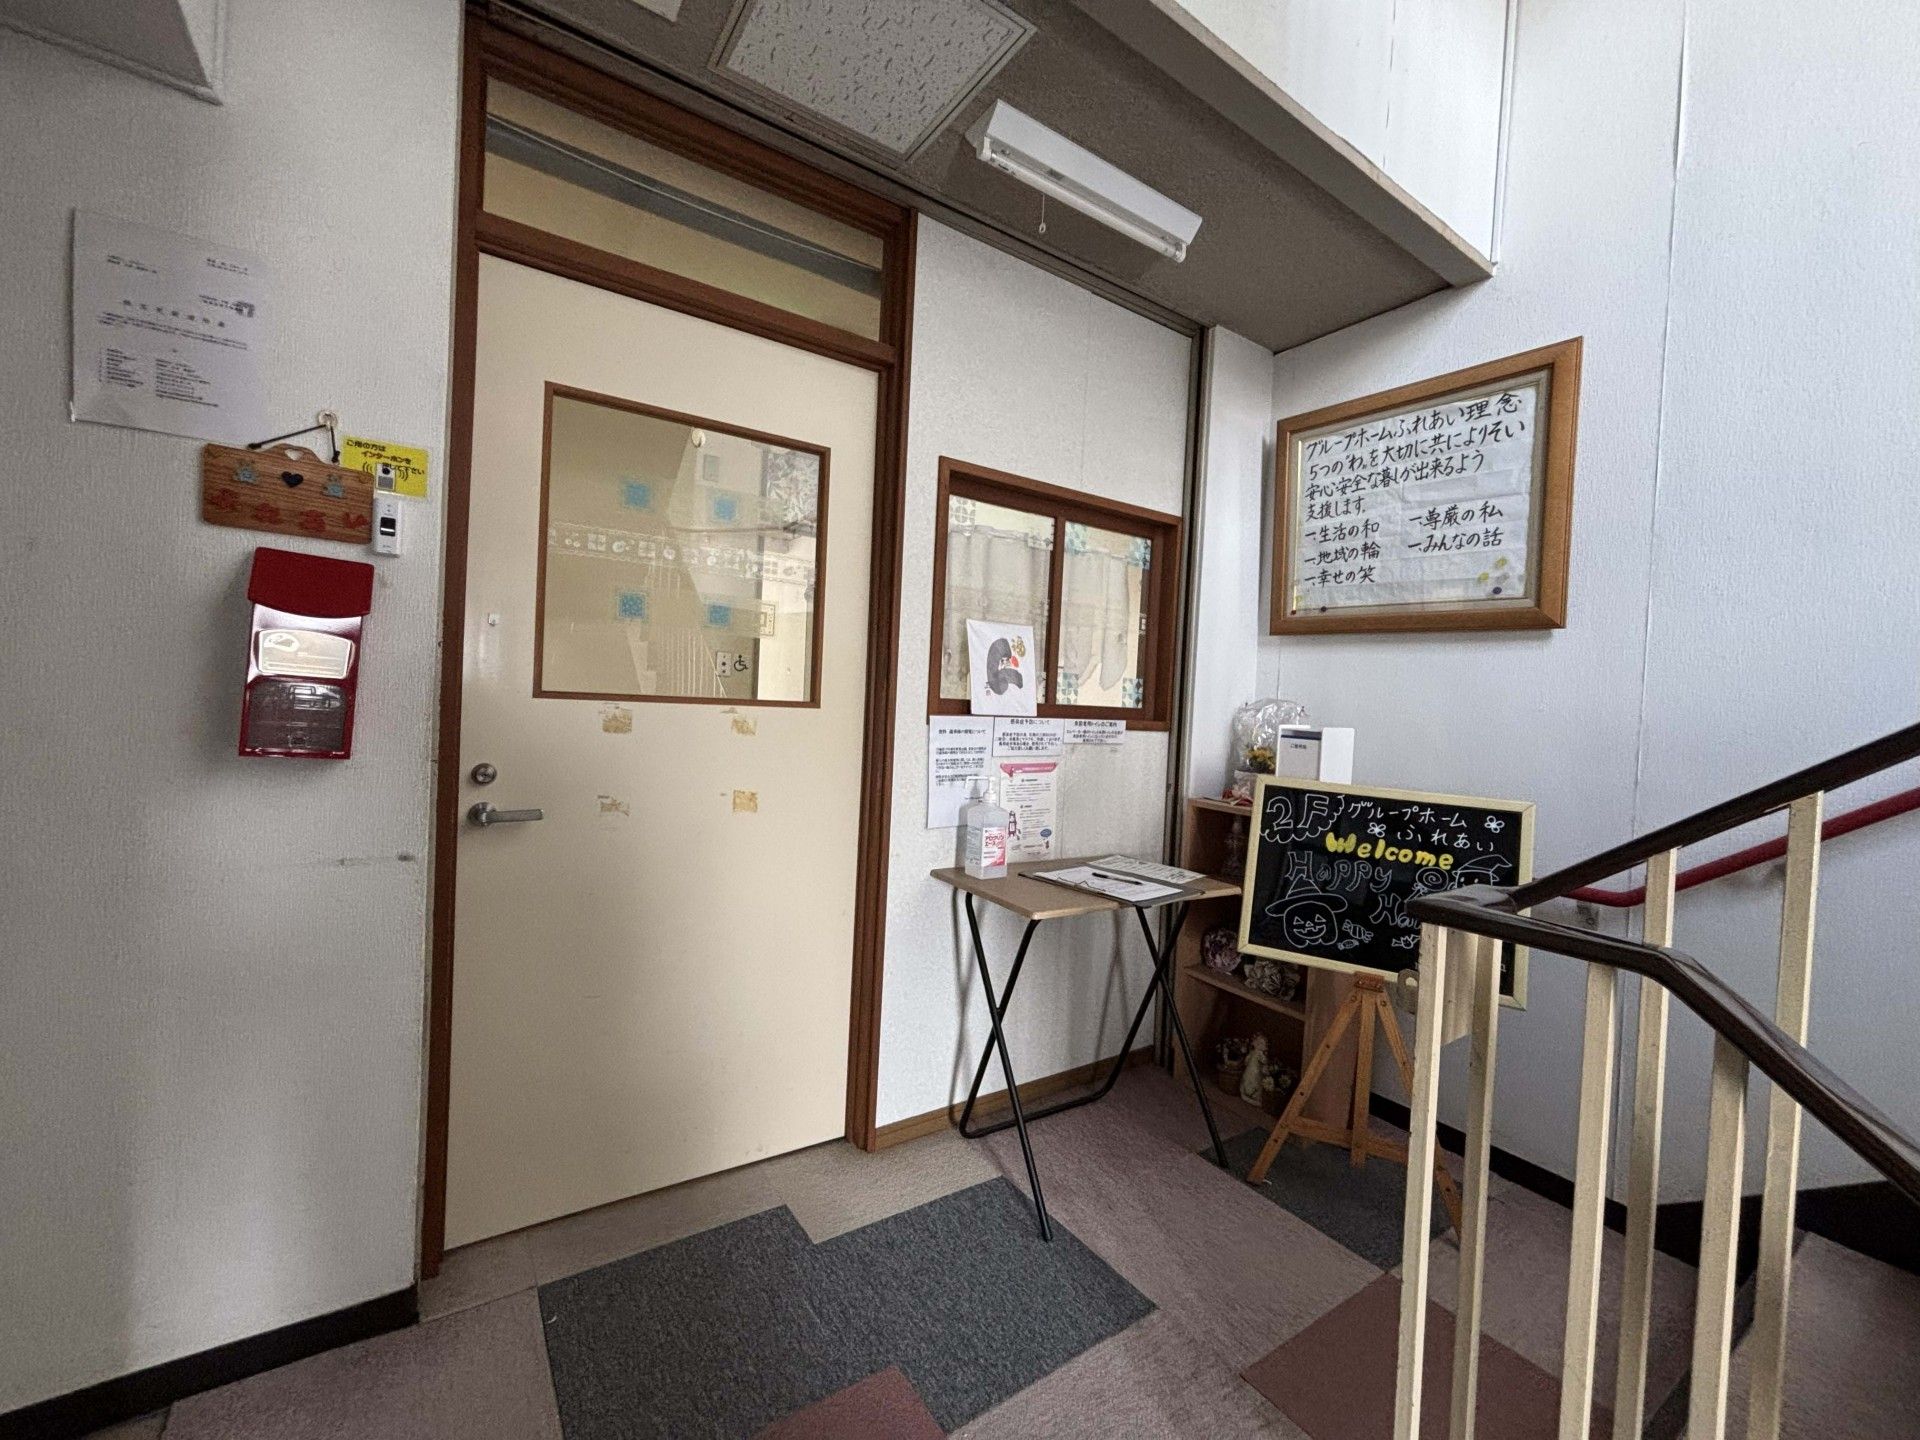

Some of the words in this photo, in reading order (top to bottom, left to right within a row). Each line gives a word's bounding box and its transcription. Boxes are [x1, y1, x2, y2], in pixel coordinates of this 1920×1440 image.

[1306, 393, 1522, 462] グループホームふれあい理念
[346, 439, 387, 452] ご用の方は
[361, 450, 412, 465] インターホンを
[1266, 793, 1330, 830] 2F
[1348, 801, 1468, 828] グループホーム
[1325, 832, 1454, 870] Welcome
[1397, 824, 1494, 851] ふれあい
